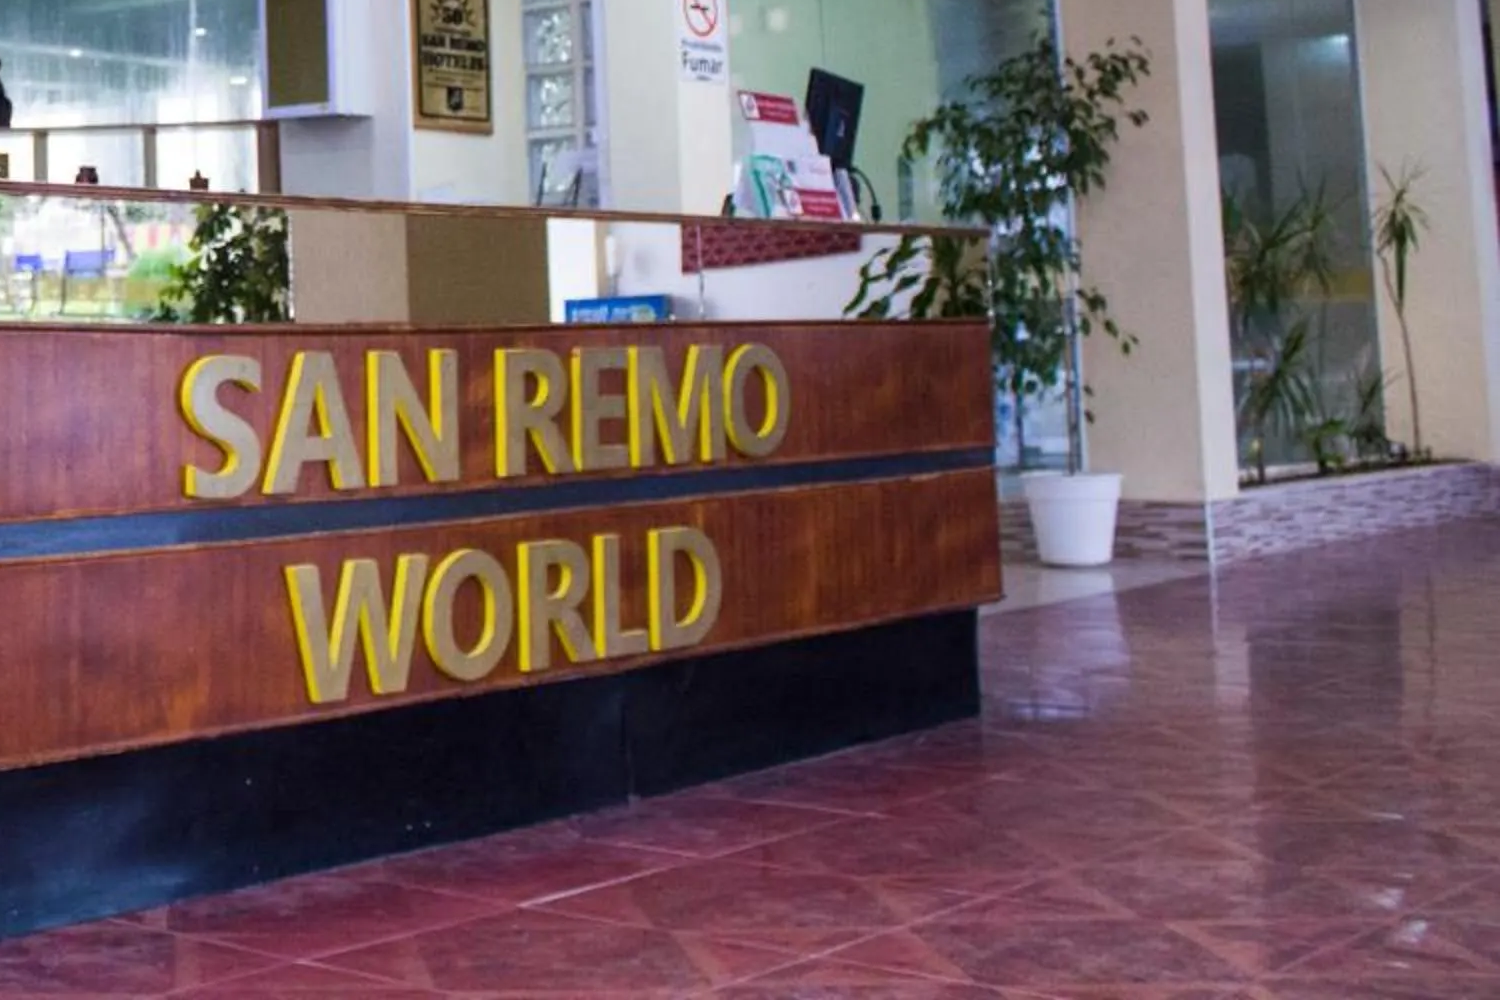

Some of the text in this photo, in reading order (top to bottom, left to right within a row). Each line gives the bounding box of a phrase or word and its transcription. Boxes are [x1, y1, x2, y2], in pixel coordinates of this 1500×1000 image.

[681, 51, 723, 75] Fumar
[180, 341, 792, 500] SAN REMO
[284, 526, 722, 704] WORLD
